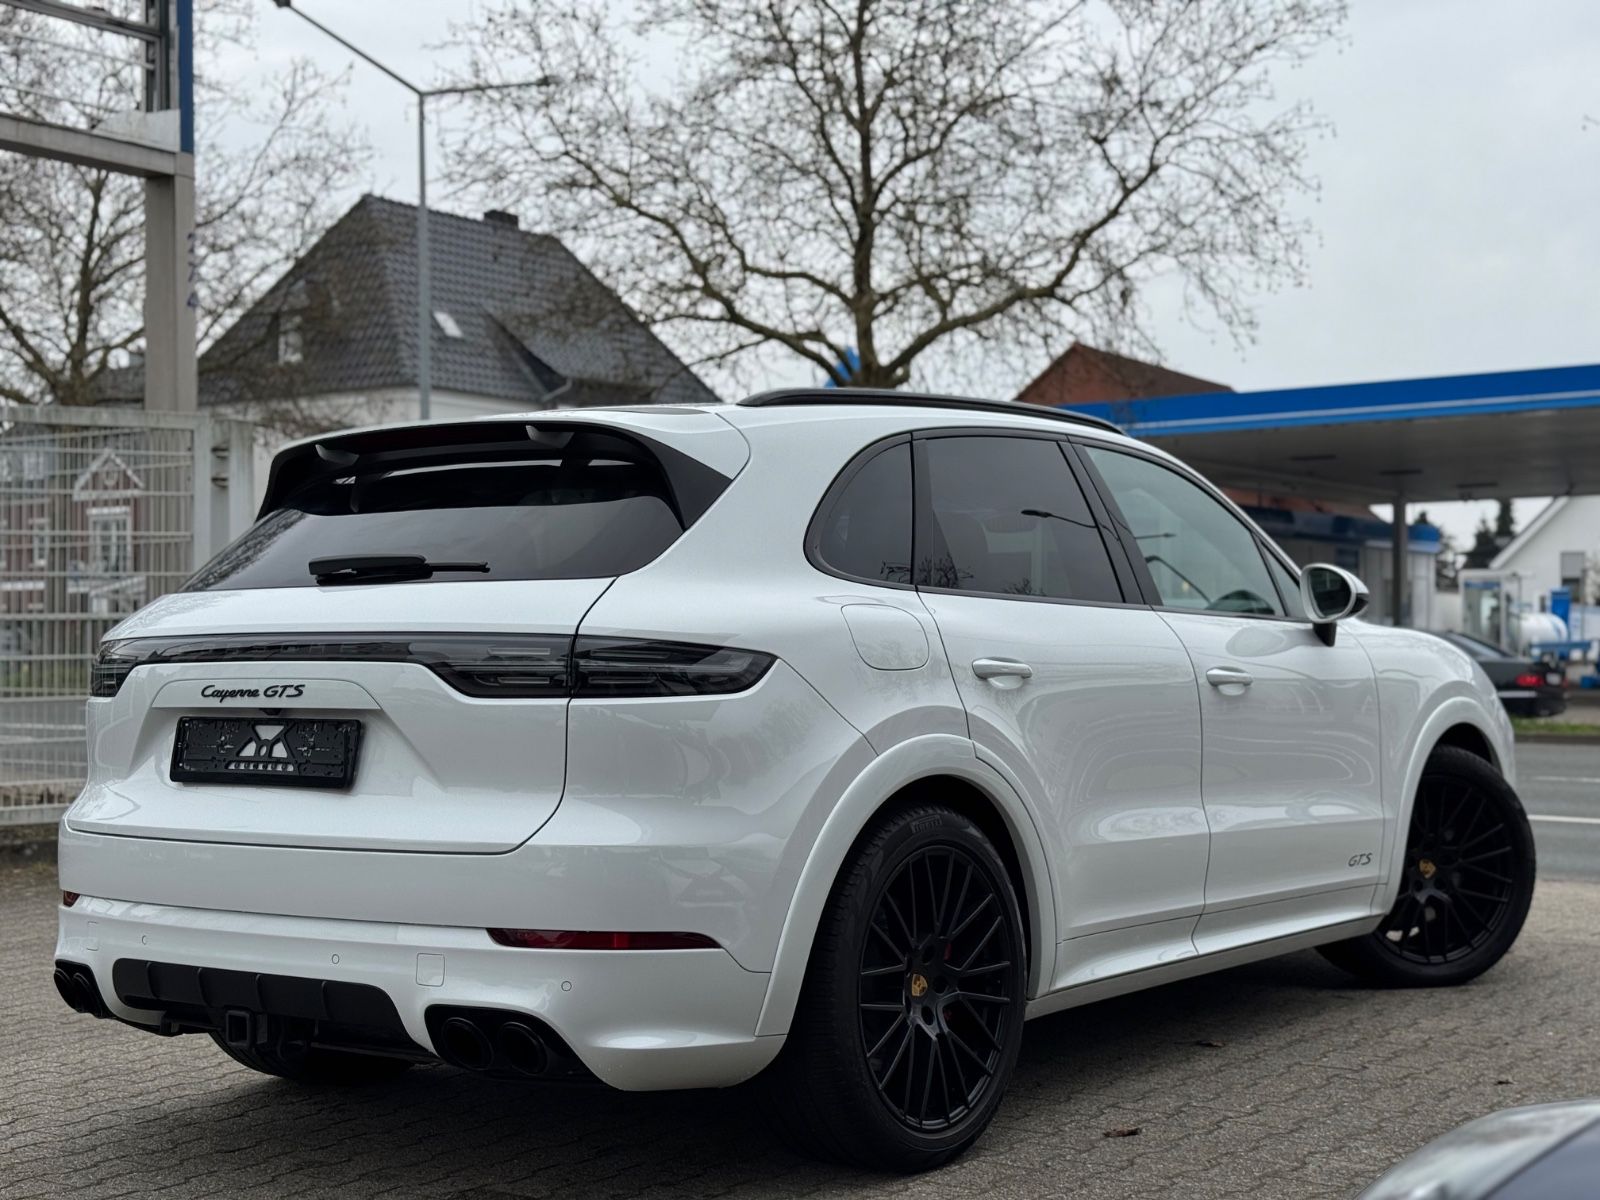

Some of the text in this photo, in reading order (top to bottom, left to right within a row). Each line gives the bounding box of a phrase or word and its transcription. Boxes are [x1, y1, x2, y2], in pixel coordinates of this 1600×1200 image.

[200, 684, 306, 704] Cayenne GTS
[1348, 852, 1373, 867] GTS
